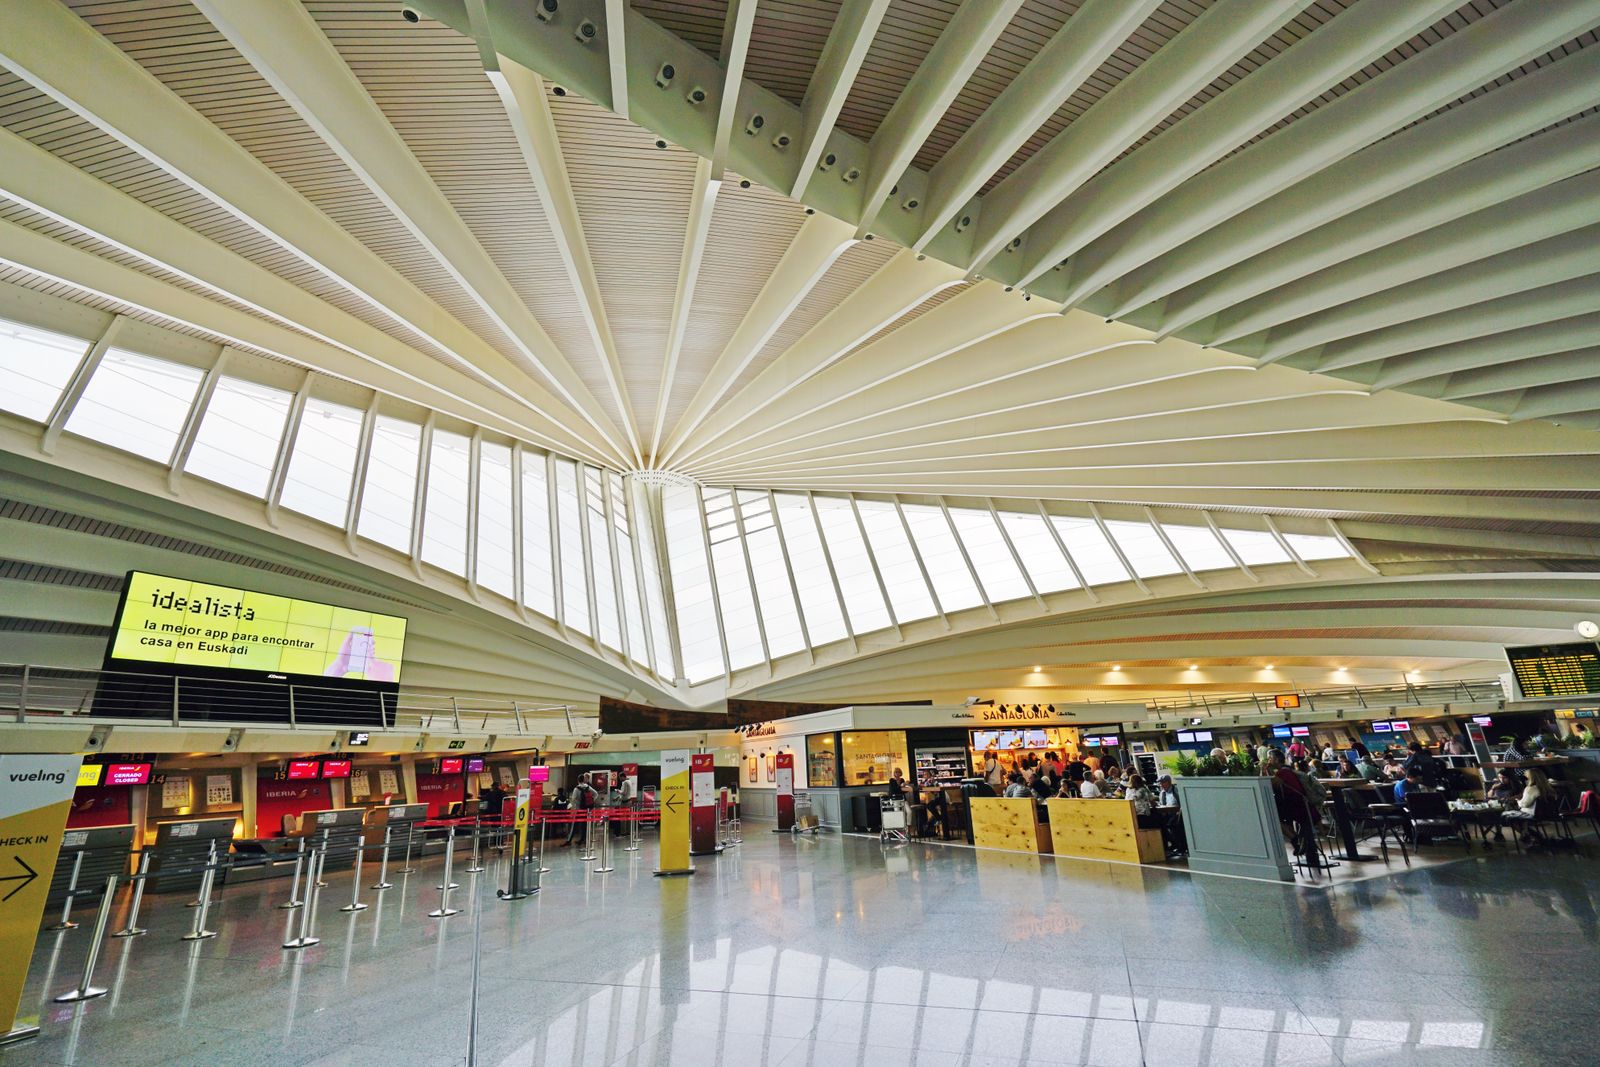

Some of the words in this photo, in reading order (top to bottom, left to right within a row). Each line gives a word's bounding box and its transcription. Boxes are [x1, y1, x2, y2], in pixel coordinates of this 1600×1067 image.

[151, 588, 255, 621] idealista
[144, 619, 157, 630] la
[161, 622, 202, 638] mejor
[205, 628, 228, 641] app
[231, 631, 259, 643] para
[262, 636, 315, 649] encontrar
[140, 637, 173, 648] casa
[177, 640, 193, 650] en
[198, 642, 249, 655] Euskadi
[983, 710, 1050, 720] SANTAGLORIA
[9, 769, 66, 784] vueling
[274, 771, 286, 780] 15
[351, 769, 361, 778] 16
[266, 790, 297, 798] IBERIA
[0, 836, 33, 847] HECK
[35, 835, 49, 844] IN
